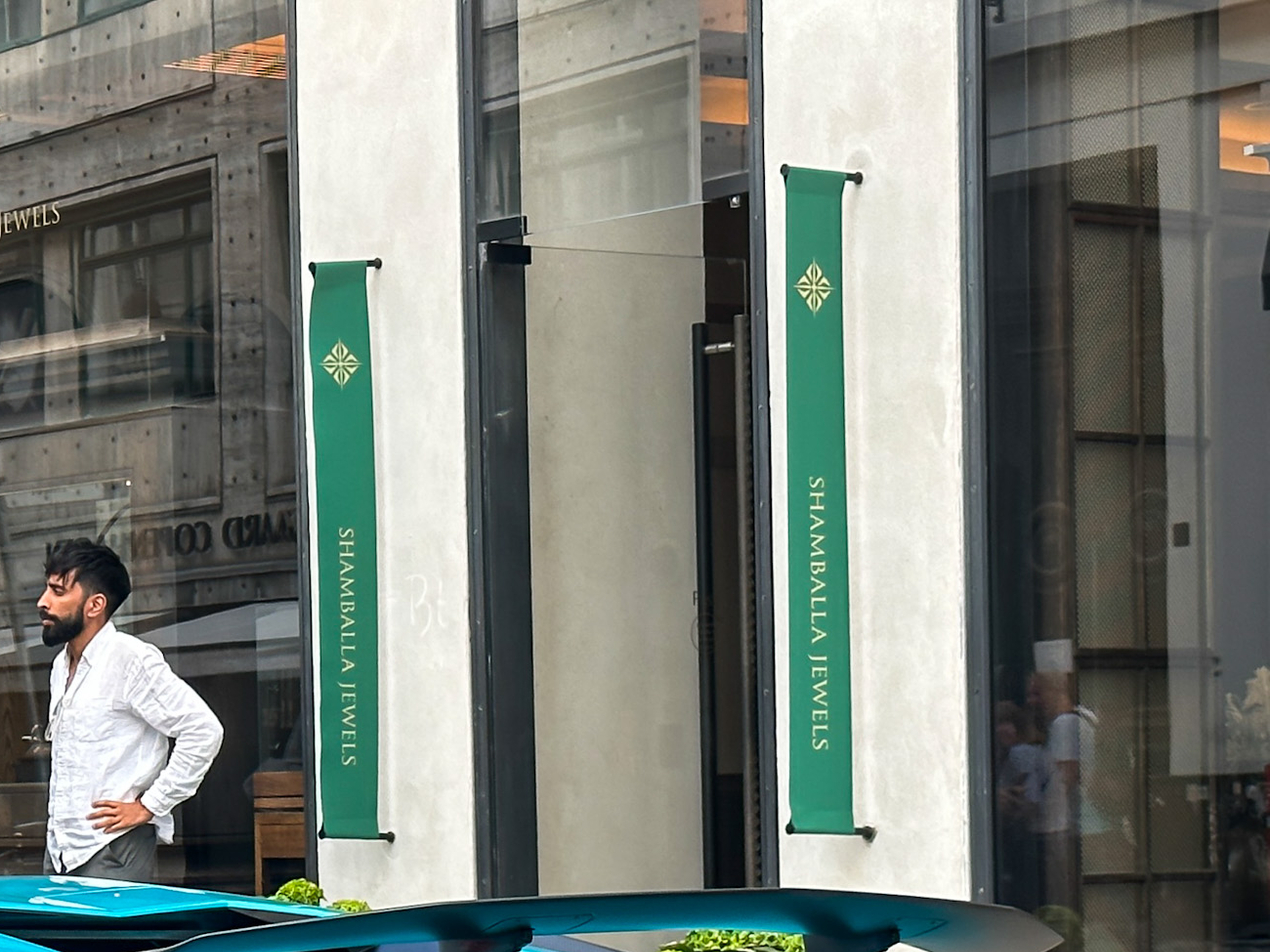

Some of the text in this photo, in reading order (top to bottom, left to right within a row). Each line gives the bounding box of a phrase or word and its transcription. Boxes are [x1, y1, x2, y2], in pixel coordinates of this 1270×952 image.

[337, 527, 357, 766] SHAMBALLA JEWELS
[808, 476, 829, 750] SHAMBALLA JEWELS
